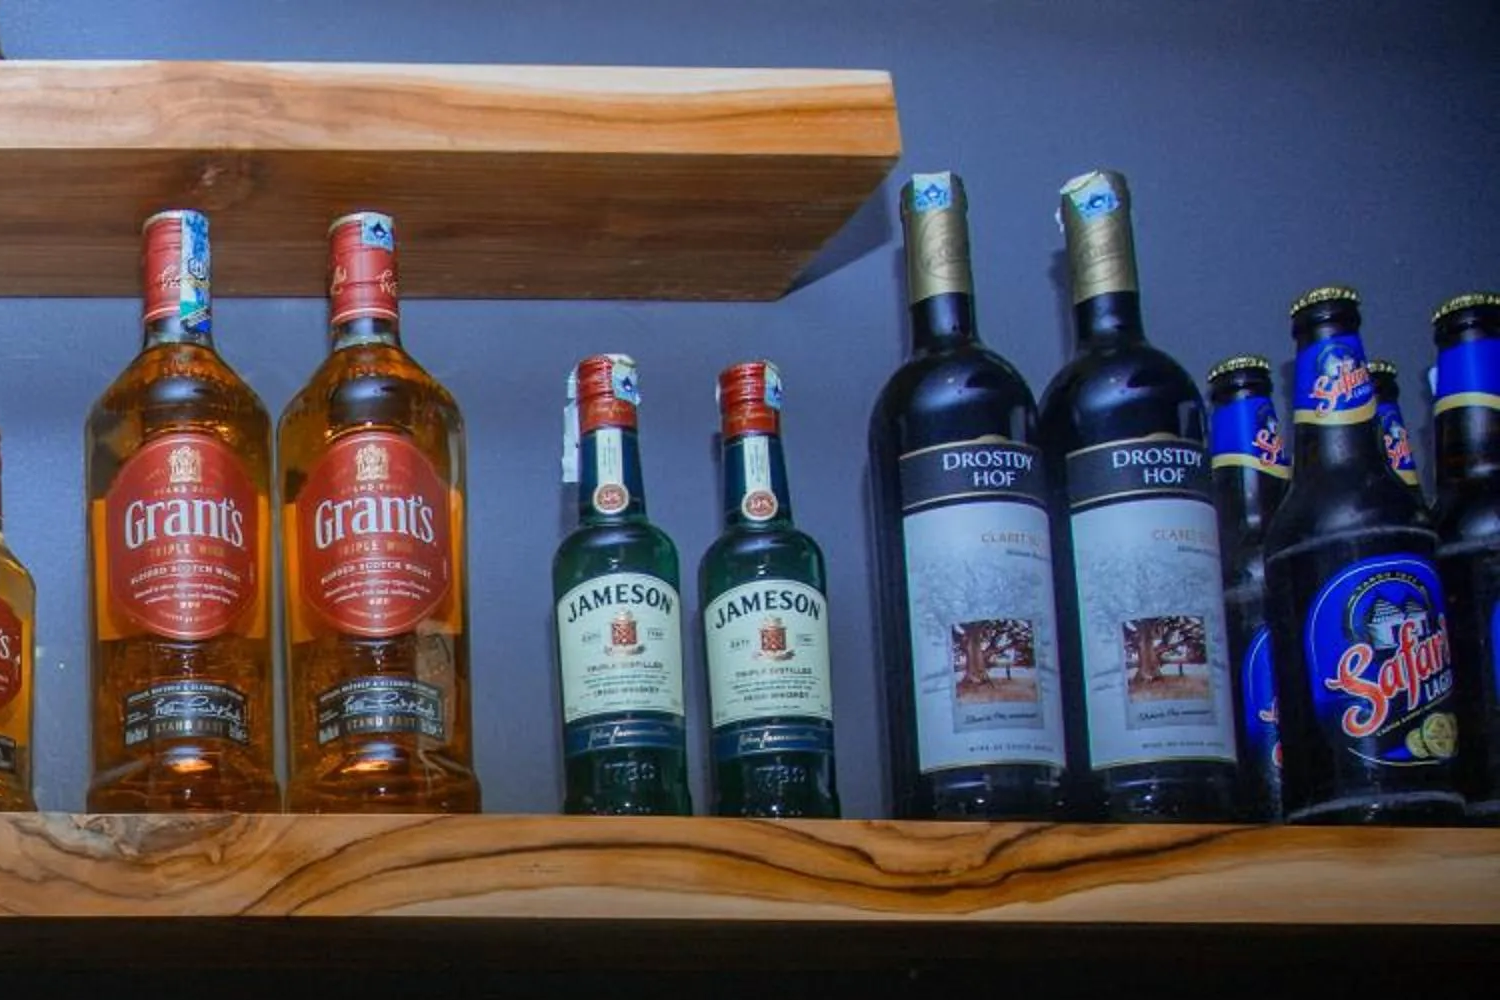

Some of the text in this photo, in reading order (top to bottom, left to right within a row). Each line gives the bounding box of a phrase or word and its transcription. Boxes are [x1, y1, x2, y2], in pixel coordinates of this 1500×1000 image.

[943, 451, 1034, 471] DROSTDY
[1111, 448, 1202, 468] DROSTDY
[973, 470, 1016, 487] HOF
[1144, 467, 1186, 484] HOF
[124, 496, 244, 550] Grant's
[315, 494, 435, 549] Grant's
[567, 583, 674, 623] JAMESON
[715, 589, 821, 630] JAMESON
